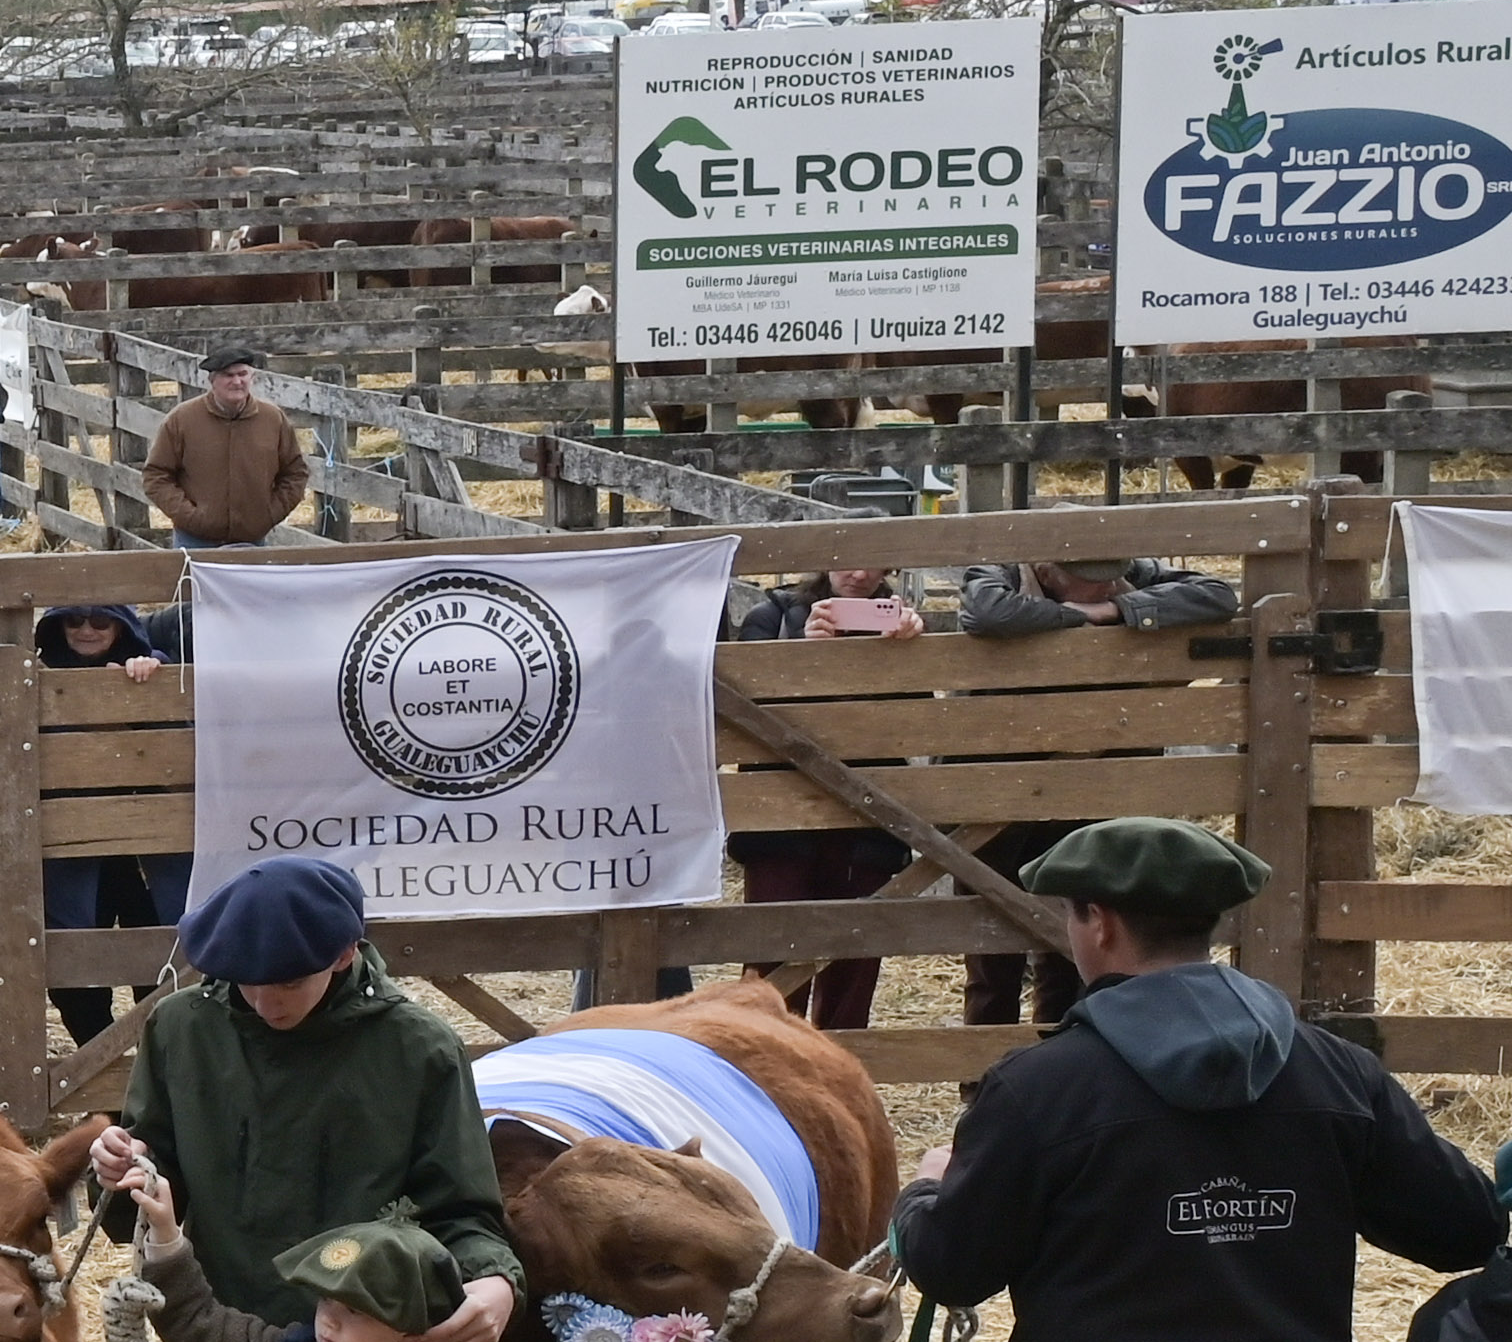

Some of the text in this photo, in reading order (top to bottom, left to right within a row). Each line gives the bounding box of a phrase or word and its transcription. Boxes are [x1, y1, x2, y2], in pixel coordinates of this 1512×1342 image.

[707, 47, 953, 71] REPRODUCCIÓN SANIDAD
[1296, 43, 1426, 70] Artículos
[646, 64, 1015, 94] NUTRICIÓN PRODUCTOS VETERINARIOS
[733, 88, 925, 110] ARTÍCULOS RURALES
[1281, 140, 1471, 168] Juan Antonio
[701, 146, 1024, 198] EL RODEO
[703, 193, 1019, 220] VETERINARIA
[1164, 163, 1485, 242] FAZZIO
[649, 233, 1009, 263] SOLUCIONES VETERINARIAS INTEGRALES
[1233, 227, 1419, 244] SOLUCIONES RURALES
[685, 272, 798, 289] Guillermo Jáuregui
[828, 266, 968, 283] María Luisa Castiglione
[1141, 276, 1512, 308] Rocamora 188 Tel.: 03446 42423
[647, 313, 1005, 348] Tel.: 03446 426046 Urquiza 2142
[1253, 305, 1407, 332] Gualeguaychú
[367, 601, 549, 687] SOCIEDAD RURAL
[418, 657, 497, 675] LABORE
[446, 679, 470, 695] ET
[402, 698, 514, 717] COSTANTIA
[373, 700, 542, 775] GUALEGUAYCHÚ
[247, 802, 671, 852] SOCIEDAD RURAL
[357, 849, 653, 900] LEGUAYCHÚ
[1178, 1195, 1288, 1221] EL FORTÍN
